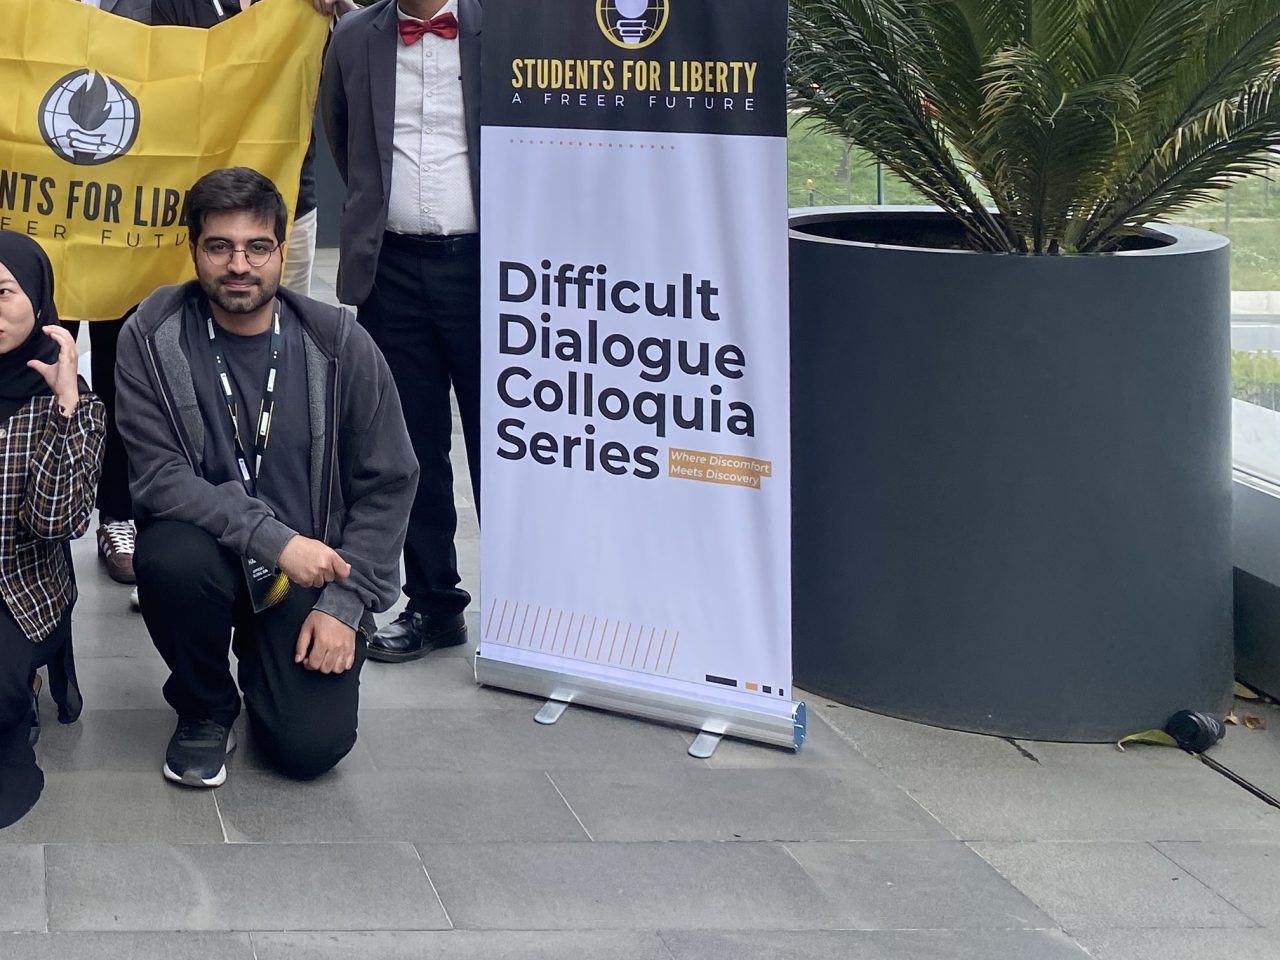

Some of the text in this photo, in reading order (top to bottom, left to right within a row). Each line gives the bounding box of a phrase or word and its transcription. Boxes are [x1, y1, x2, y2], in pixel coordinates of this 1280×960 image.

[511, 58, 757, 94] STUDENTS FOR LIBERTY
[511, 92, 754, 111] A FREER FUTURE
[66, 180, 123, 223] FOR
[133, 185, 189, 227] LIBE
[101, 229, 187, 249] FUTU
[498, 259, 720, 321] Difficult
[498, 312, 746, 383] Dialogue
[496, 366, 755, 438] Colloquia
[496, 418, 660, 479] Series
[671, 450, 770, 473] Where Discomfort
[670, 464, 759, 486] Meets Discovery
